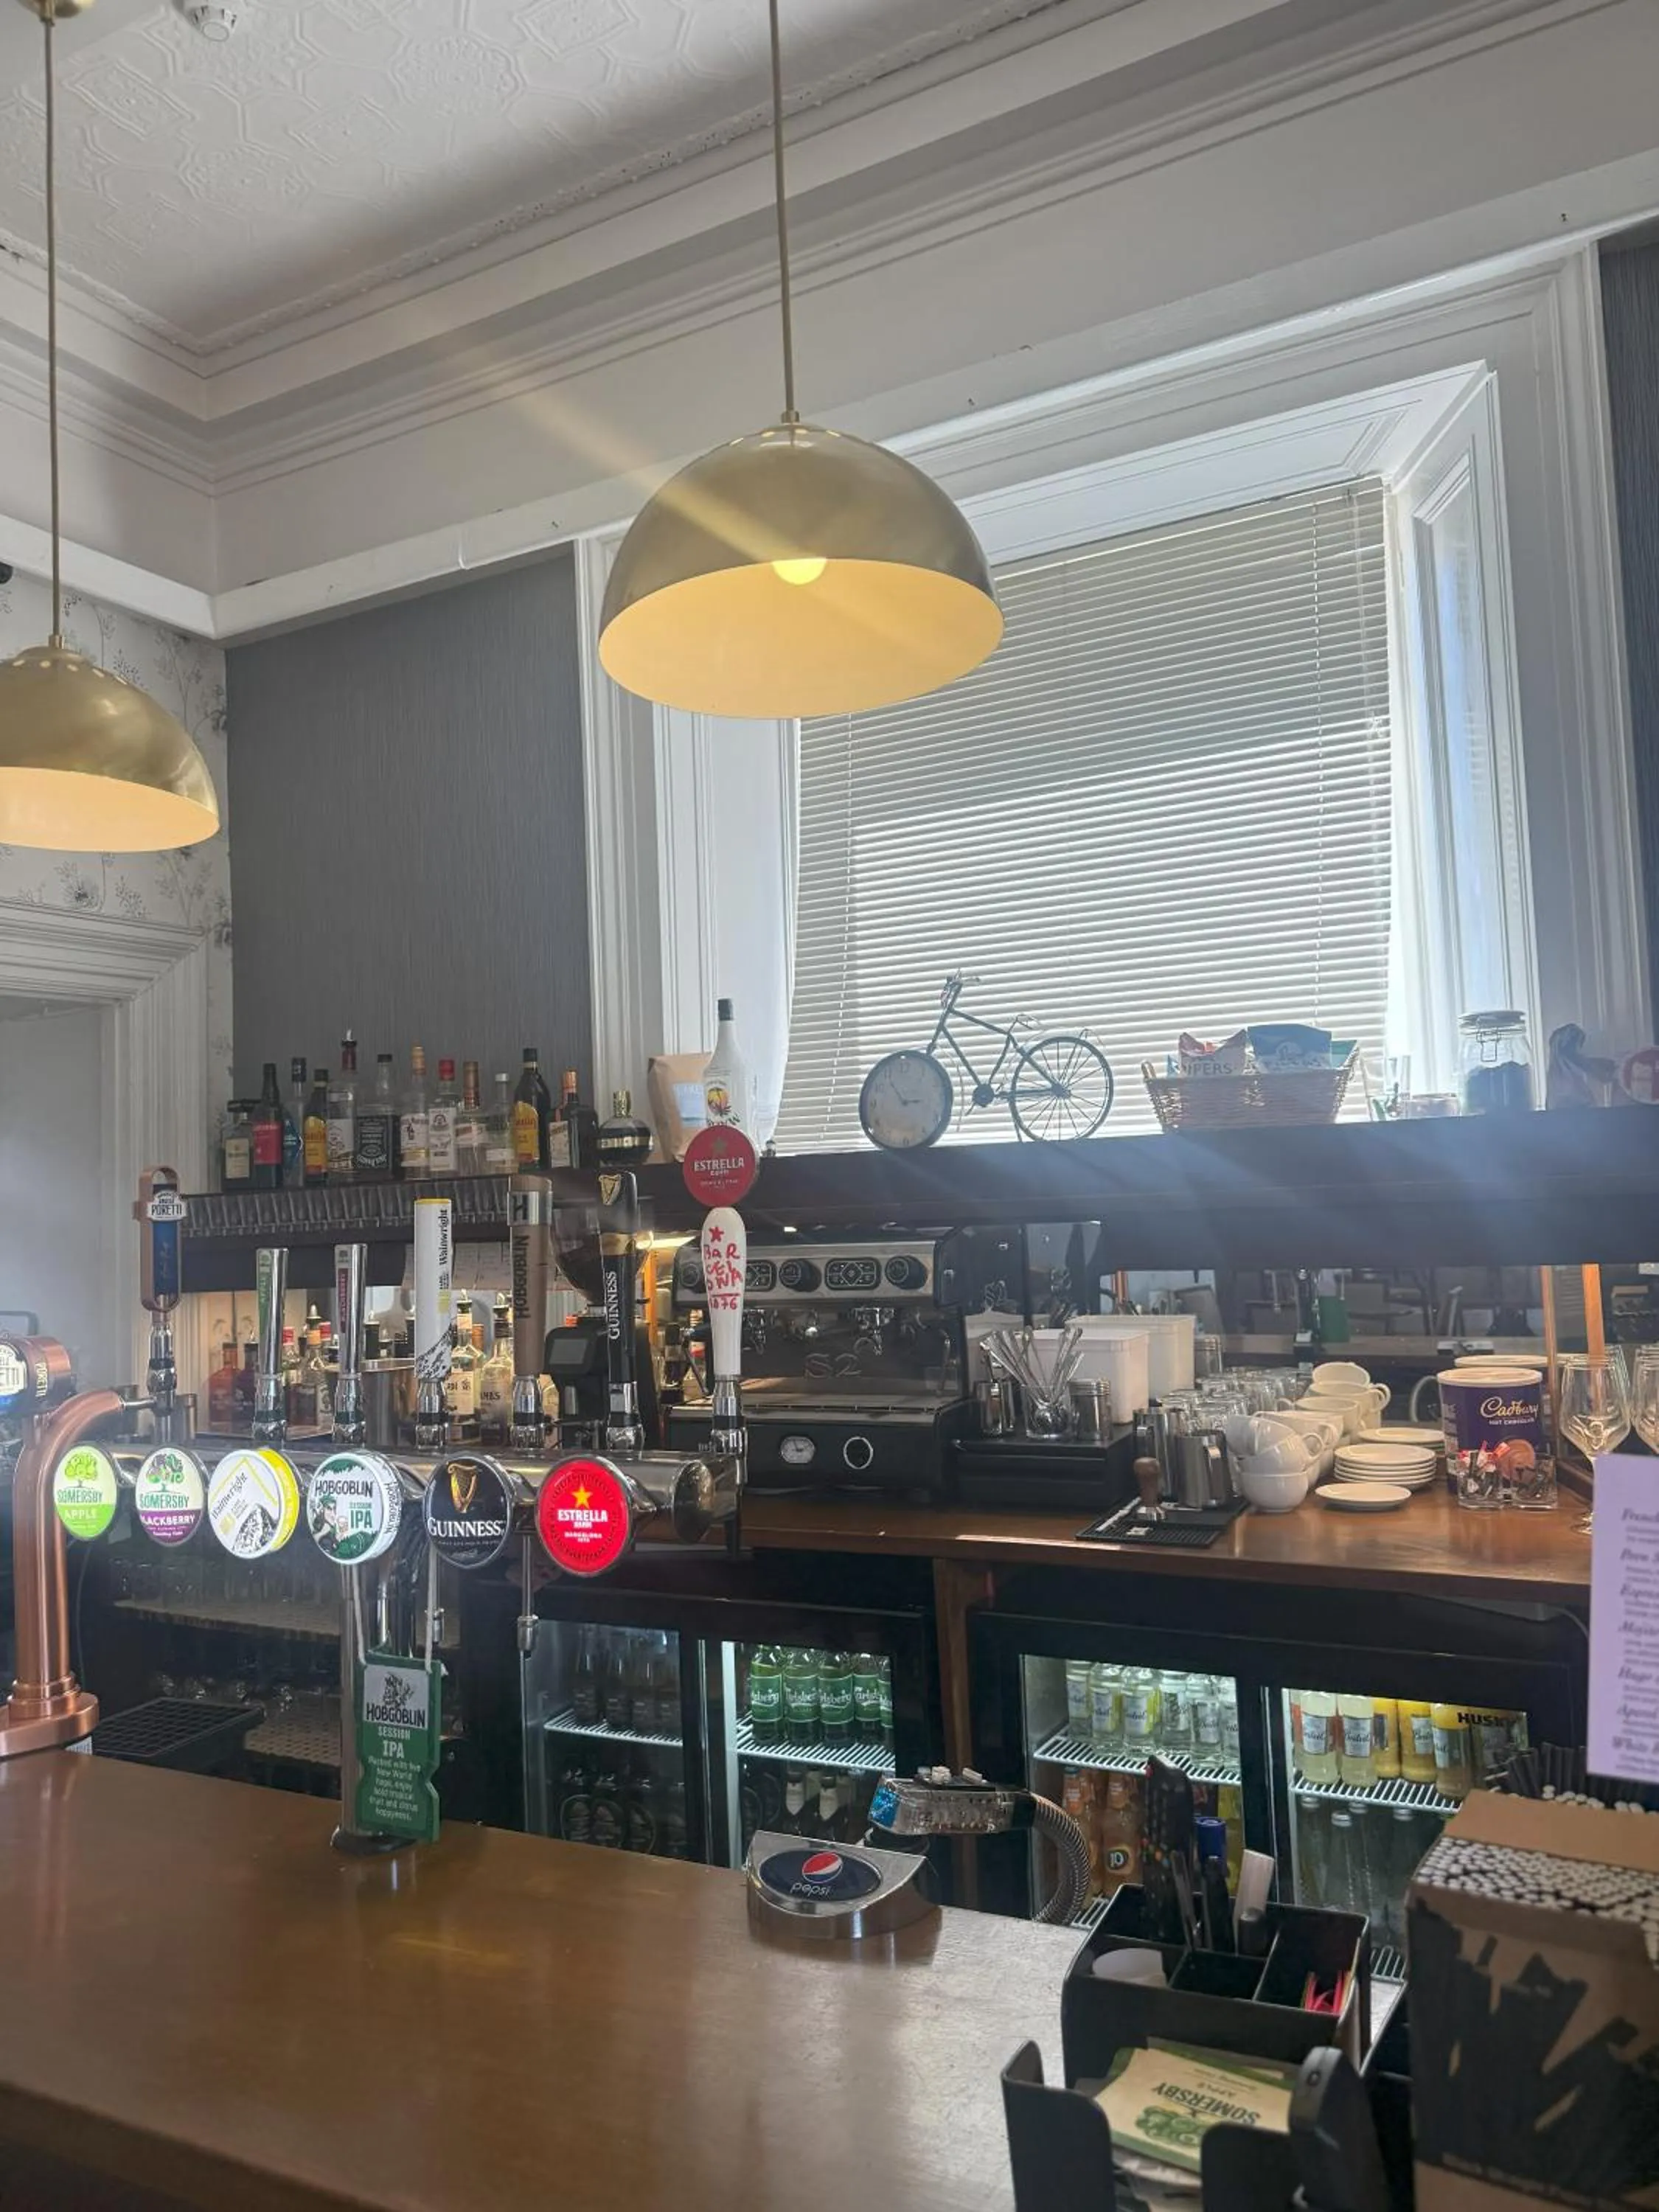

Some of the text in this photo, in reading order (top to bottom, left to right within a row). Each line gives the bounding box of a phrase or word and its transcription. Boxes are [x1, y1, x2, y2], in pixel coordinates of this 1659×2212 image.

[694, 1157, 745, 1172] ESTRELLA
[438, 1209, 449, 1265] Wainwright
[513, 1235, 531, 1319] HOBGOBLIN
[606, 1270, 621, 1340] GUINNESS
[806, 1353, 862, 1378] S2
[1481, 1396, 1539, 1419] Cadbury
[57, 1489, 102, 1503] SOMERSBY
[315, 1480, 373, 1498] HOBGOBLIN
[139, 1492, 189, 1509] SOMERSBY
[64, 1509, 96, 1520] APPLE
[141, 1514, 195, 1527] LACKBERRY
[350, 1509, 372, 1528] IPA
[557, 1509, 608, 1523] ESTRELLA
[428, 1517, 503, 1537] GUINNESS
[366, 1703, 425, 1727] HOBGOBLIN
[378, 1726, 411, 1740] SESSION
[383, 1740, 404, 1759] IPA
[790, 1881, 832, 1896] pepsi
[1151, 2081, 1261, 2125] SOMERSBY
